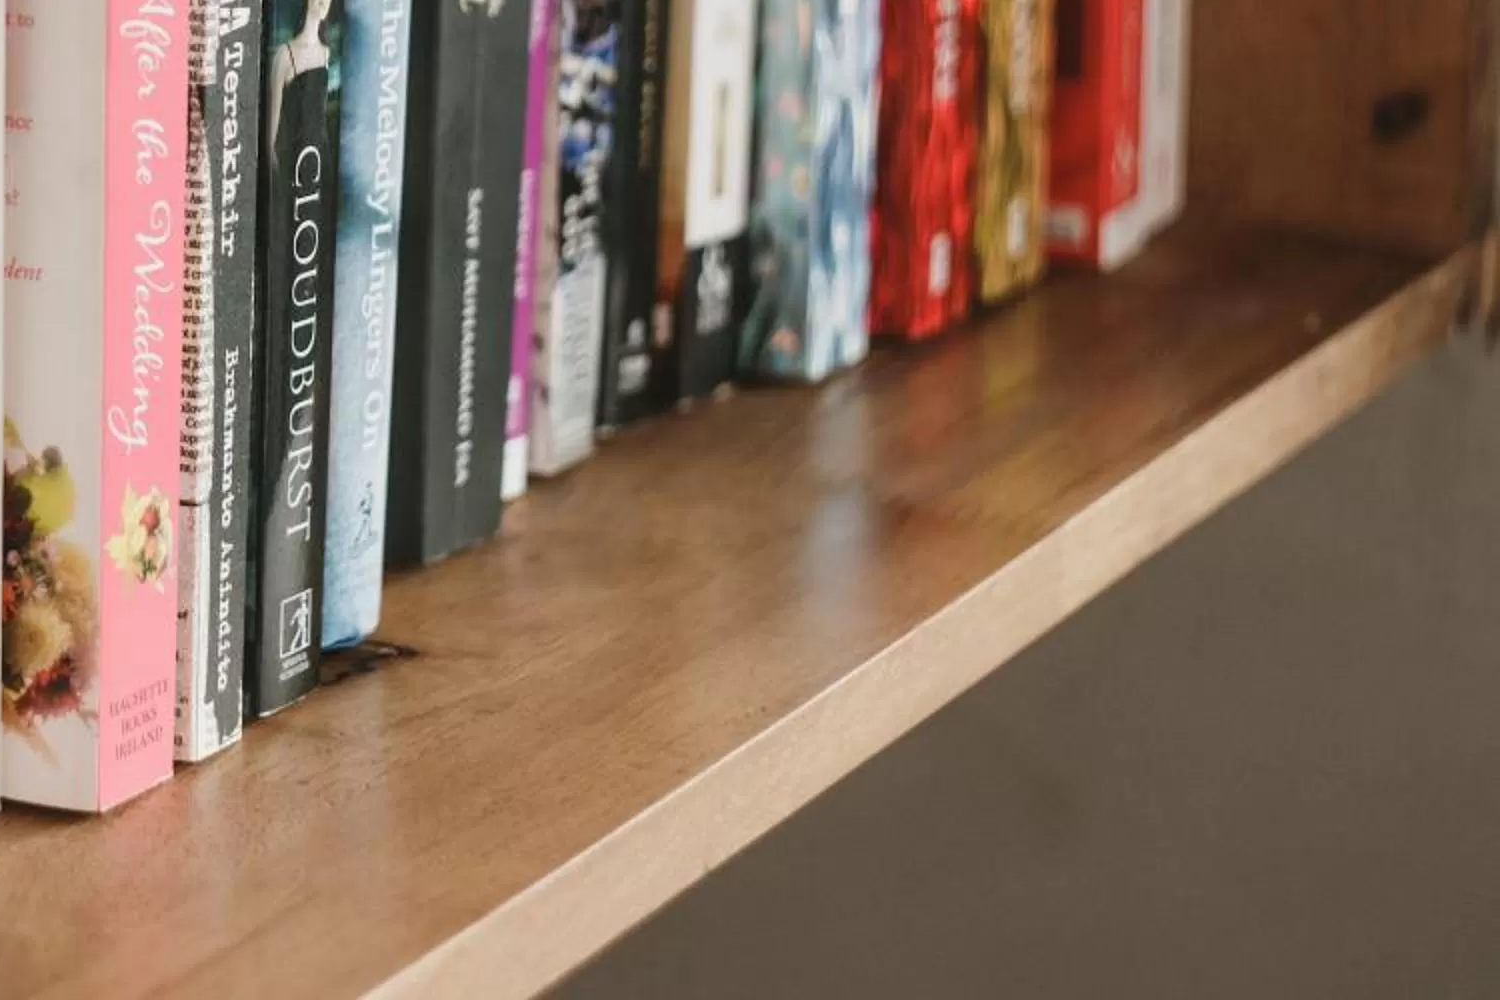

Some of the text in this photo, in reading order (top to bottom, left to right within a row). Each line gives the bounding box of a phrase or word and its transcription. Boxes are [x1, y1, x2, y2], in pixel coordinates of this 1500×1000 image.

[131, 119, 170, 187] the
[219, 41, 245, 258] Terakhir
[363, 64, 401, 215] Melody
[106, 200, 176, 456] Wedding
[285, 145, 323, 543] CLOUDBURST
[360, 229, 392, 381] Lingers
[361, 390, 386, 450] On
[215, 541, 236, 693] Anindito
